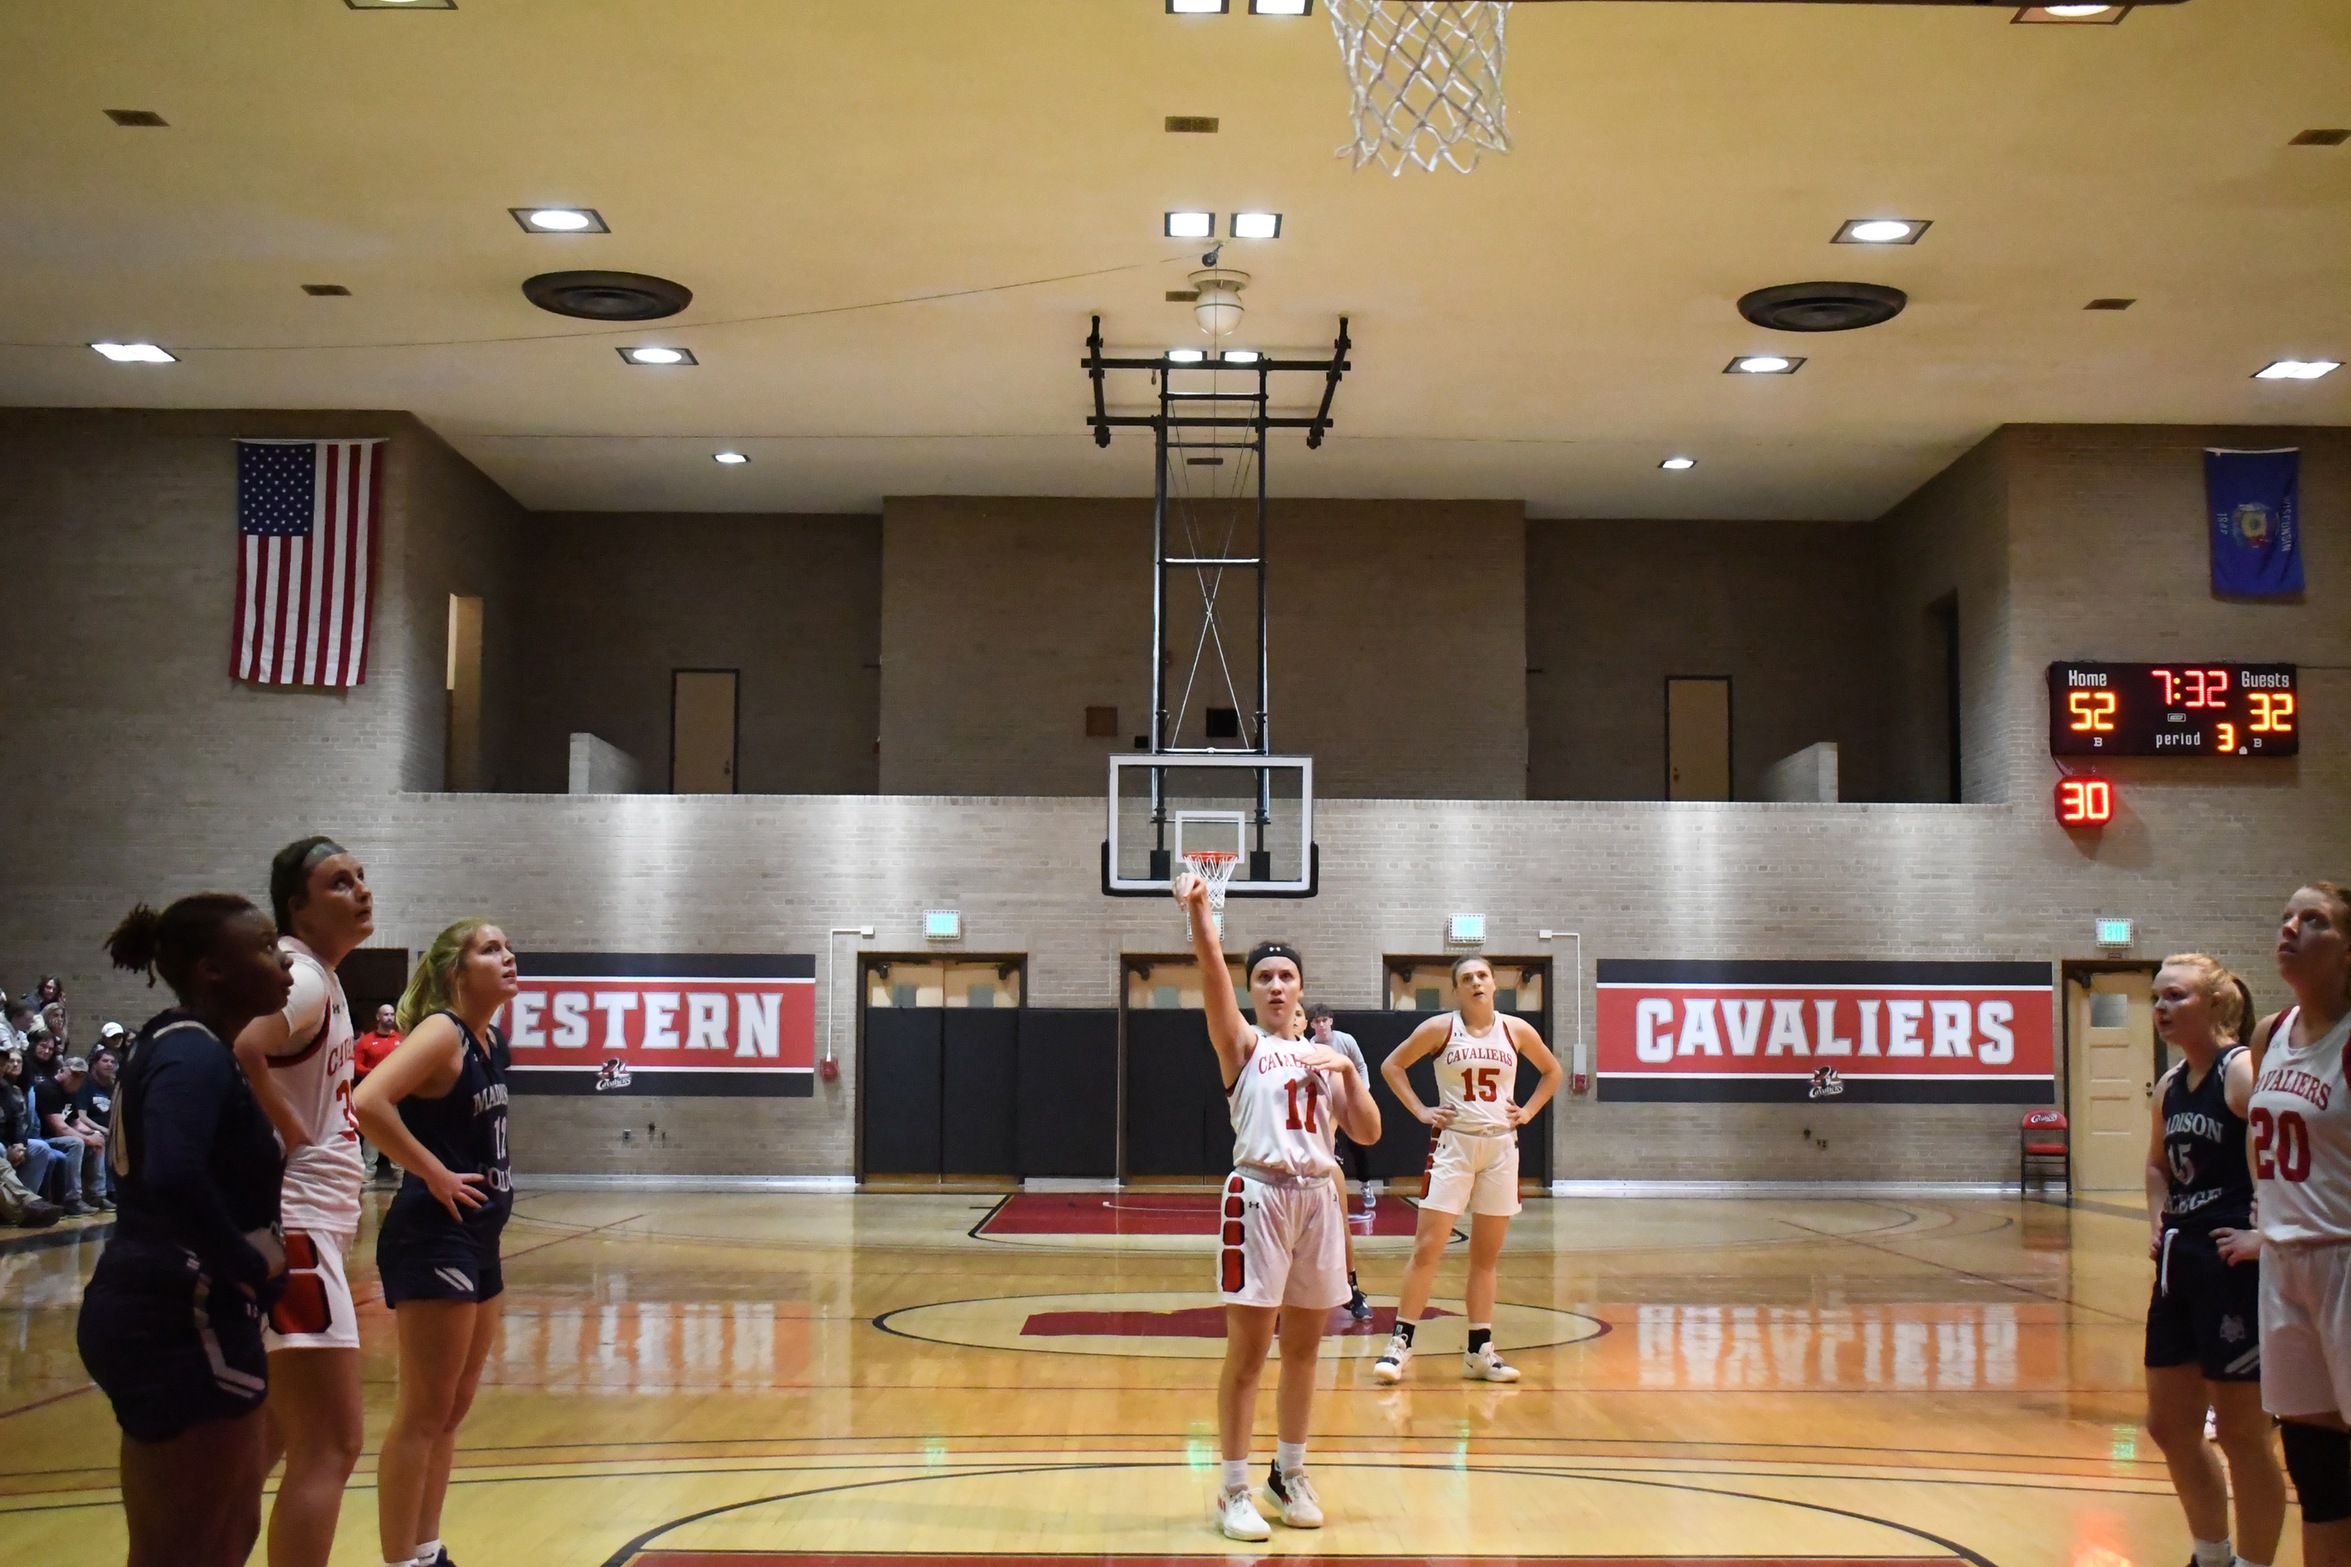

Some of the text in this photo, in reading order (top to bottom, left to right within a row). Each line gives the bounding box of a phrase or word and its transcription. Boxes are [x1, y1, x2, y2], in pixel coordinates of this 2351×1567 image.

[2068, 669, 2108, 687] Home
[2151, 670, 2228, 709] 7:32
[2241, 670, 2290, 688] Guests
[2069, 692, 2117, 731] 52
[2248, 693, 2294, 732] 32
[2094, 737, 2103, 747] B
[2155, 723, 2235, 752] period 3
[2253, 738, 2263, 748] B
[2063, 781, 2111, 820] 30
[490, 990, 784, 1058] ESTERN
[1635, 997, 2015, 1067] CAVALIERS
[1445, 1046, 1514, 1068] CAVALIERS
[1461, 1068, 1501, 1103] 15
[2253, 1069, 2332, 1111] AVALIERS
[1284, 1078, 1318, 1133] 11
[2165, 1112, 2224, 1144] ADISON
[2249, 1107, 2311, 1182] 20
[2168, 1143, 2195, 1187] 15
